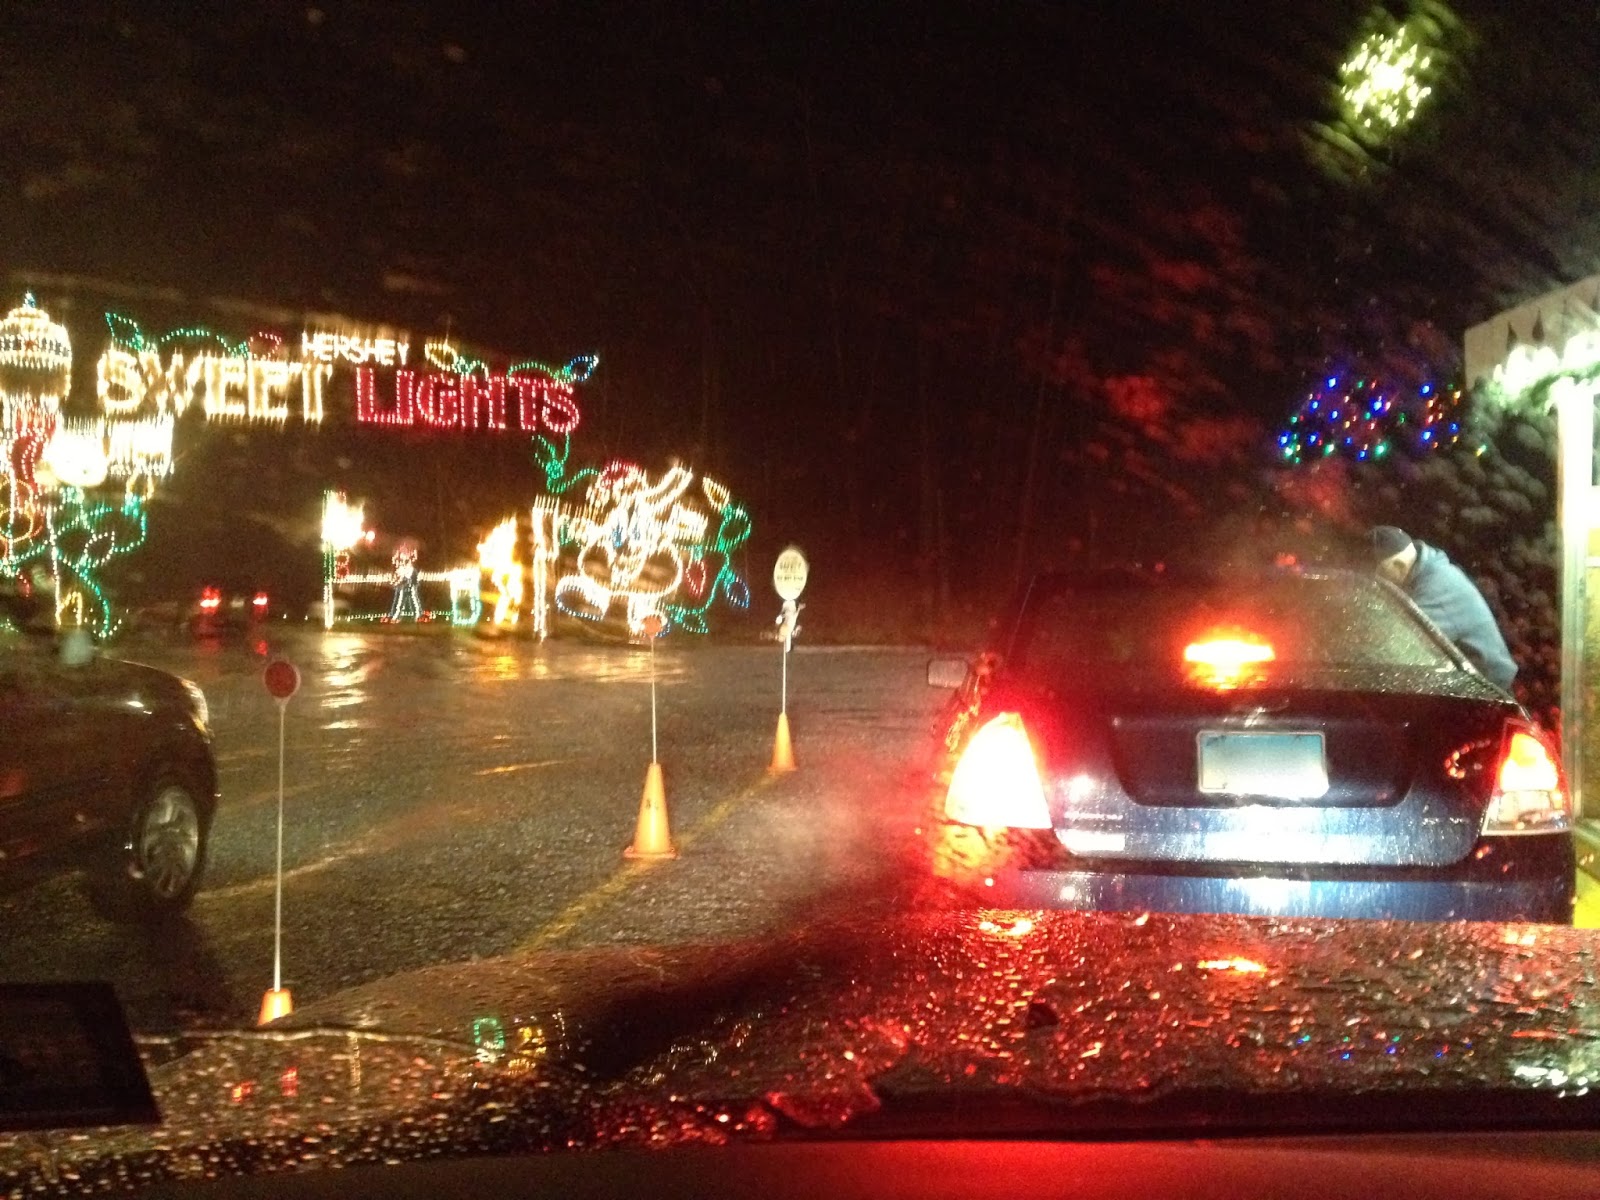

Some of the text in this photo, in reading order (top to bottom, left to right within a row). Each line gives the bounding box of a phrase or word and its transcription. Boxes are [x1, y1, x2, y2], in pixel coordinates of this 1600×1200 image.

[301, 332, 409, 366] HERSHEY
[97, 348, 581, 433] SWEET LIGHTS
